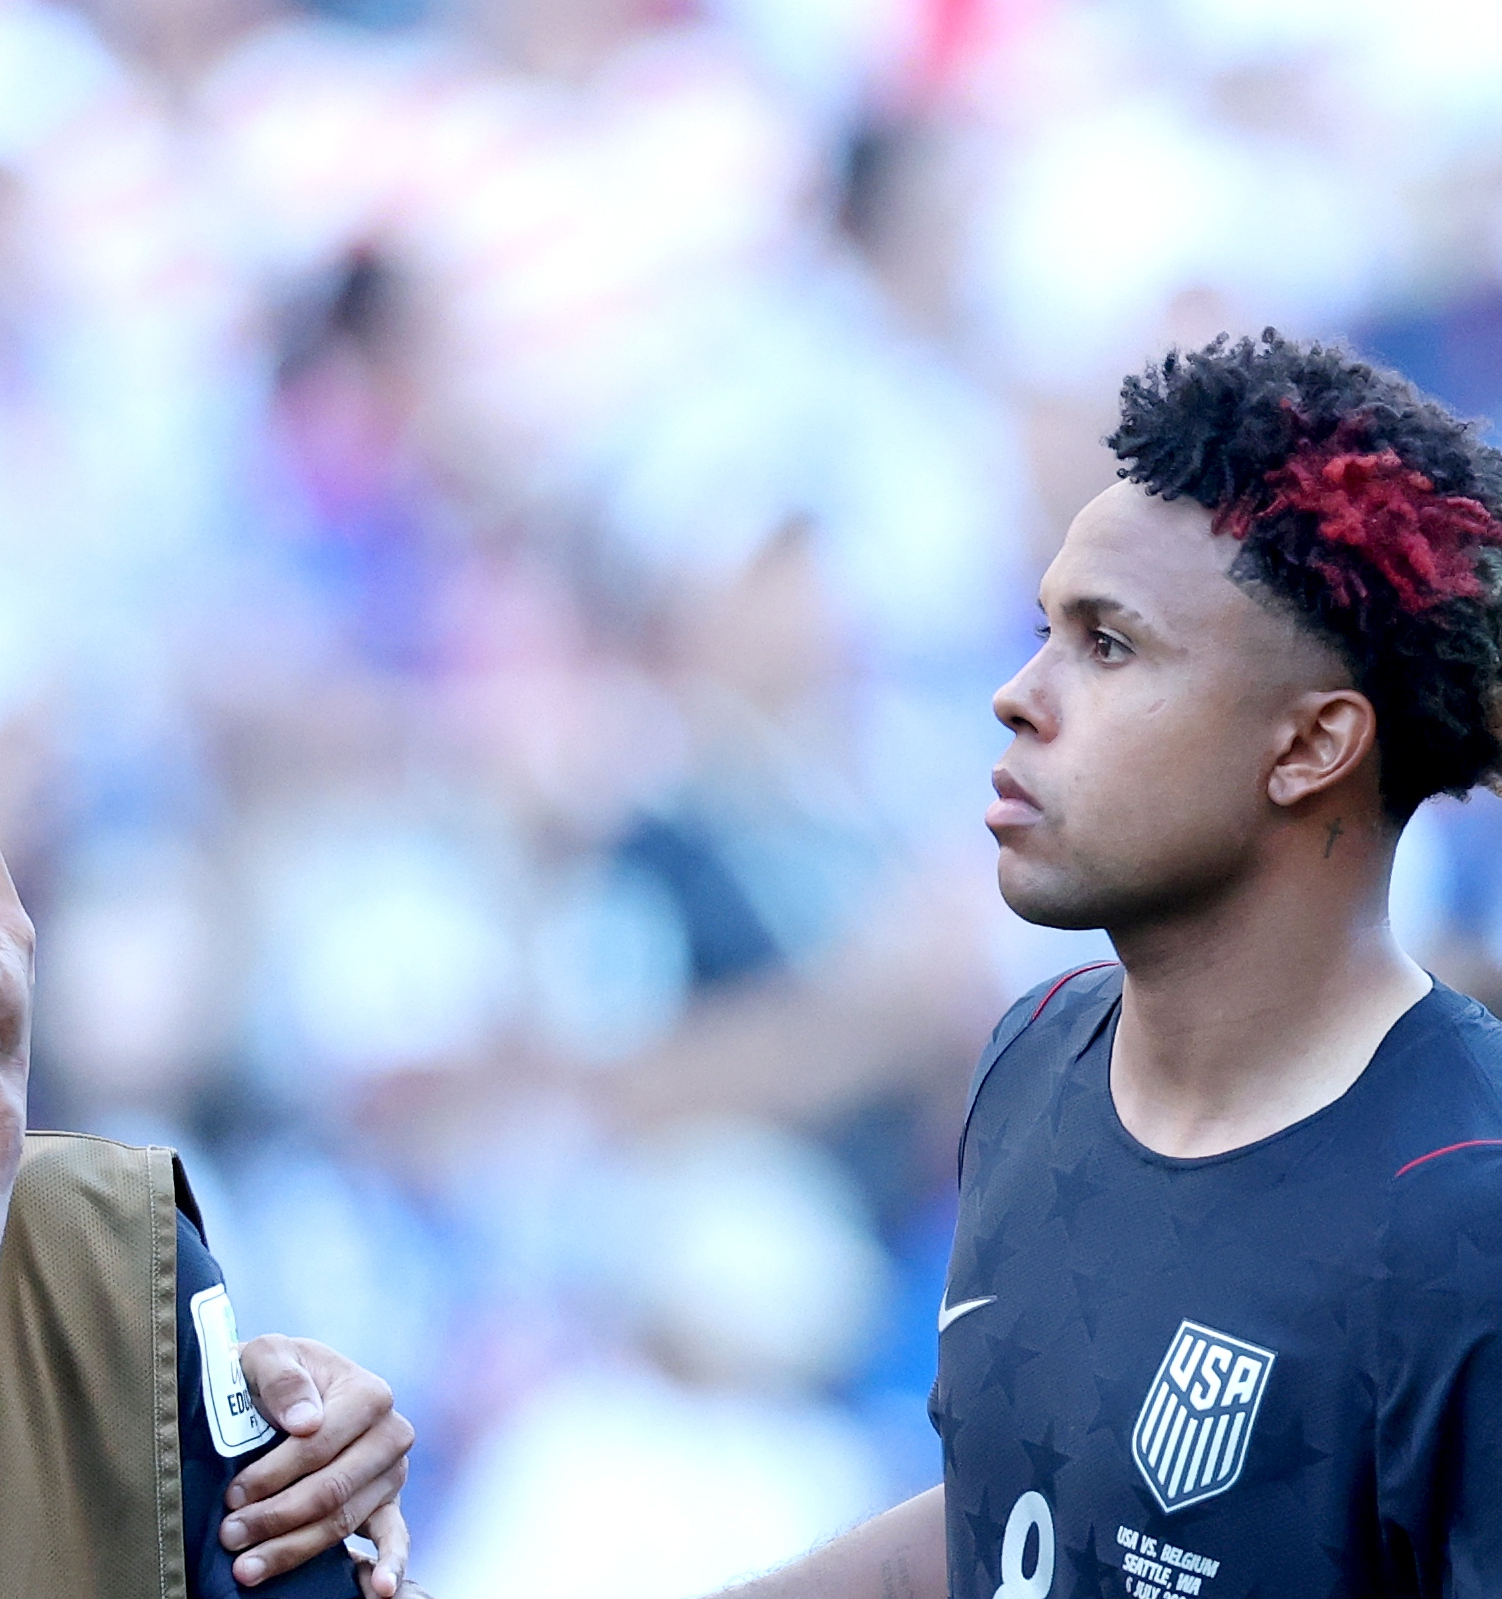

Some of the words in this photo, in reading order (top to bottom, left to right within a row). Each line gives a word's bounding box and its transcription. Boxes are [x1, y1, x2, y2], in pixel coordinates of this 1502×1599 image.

[1169, 1334, 1263, 1412] USA
[1116, 1525, 1140, 1550] USA
[1140, 1534, 1158, 1558] VS.
[1160, 1543, 1221, 1579] BELGIUM
[1122, 1551, 1173, 1590] SEATTLE,
[1175, 1572, 1202, 1596] WA
